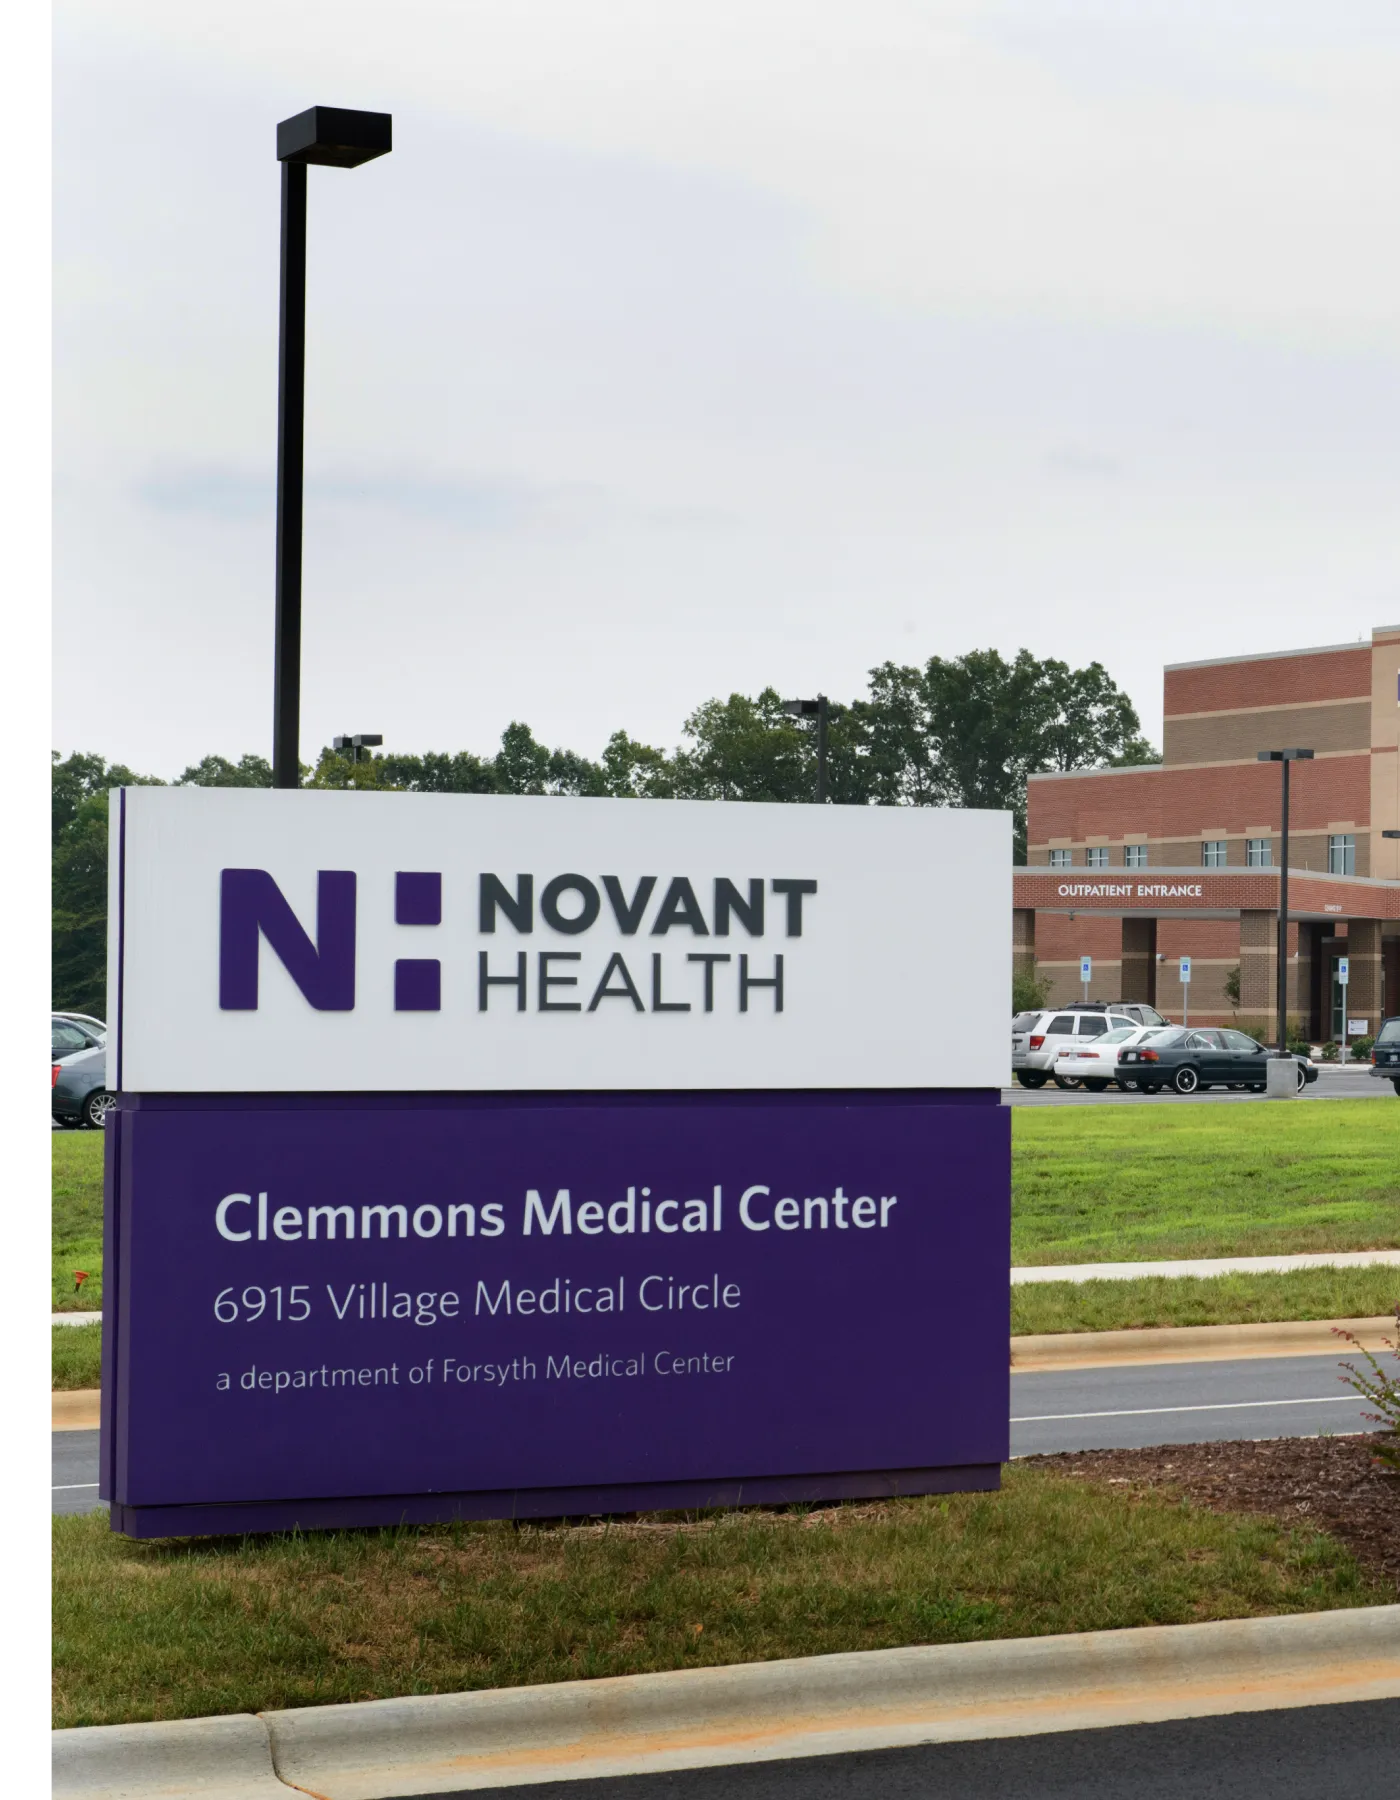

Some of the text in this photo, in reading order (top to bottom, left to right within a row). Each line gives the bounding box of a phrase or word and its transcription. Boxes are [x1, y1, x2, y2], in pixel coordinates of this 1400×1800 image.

[478, 872, 818, 938] NOVANT
[1058, 884, 1202, 897] OUTPATIENT ENTRANCE
[478, 950, 785, 1013] HEALTH
[215, 1184, 898, 1242] Clemmons Medical Center
[213, 1273, 741, 1326] 6915 Village Medical Circle
[216, 1350, 735, 1394] a department of Forsyth Medical Center
